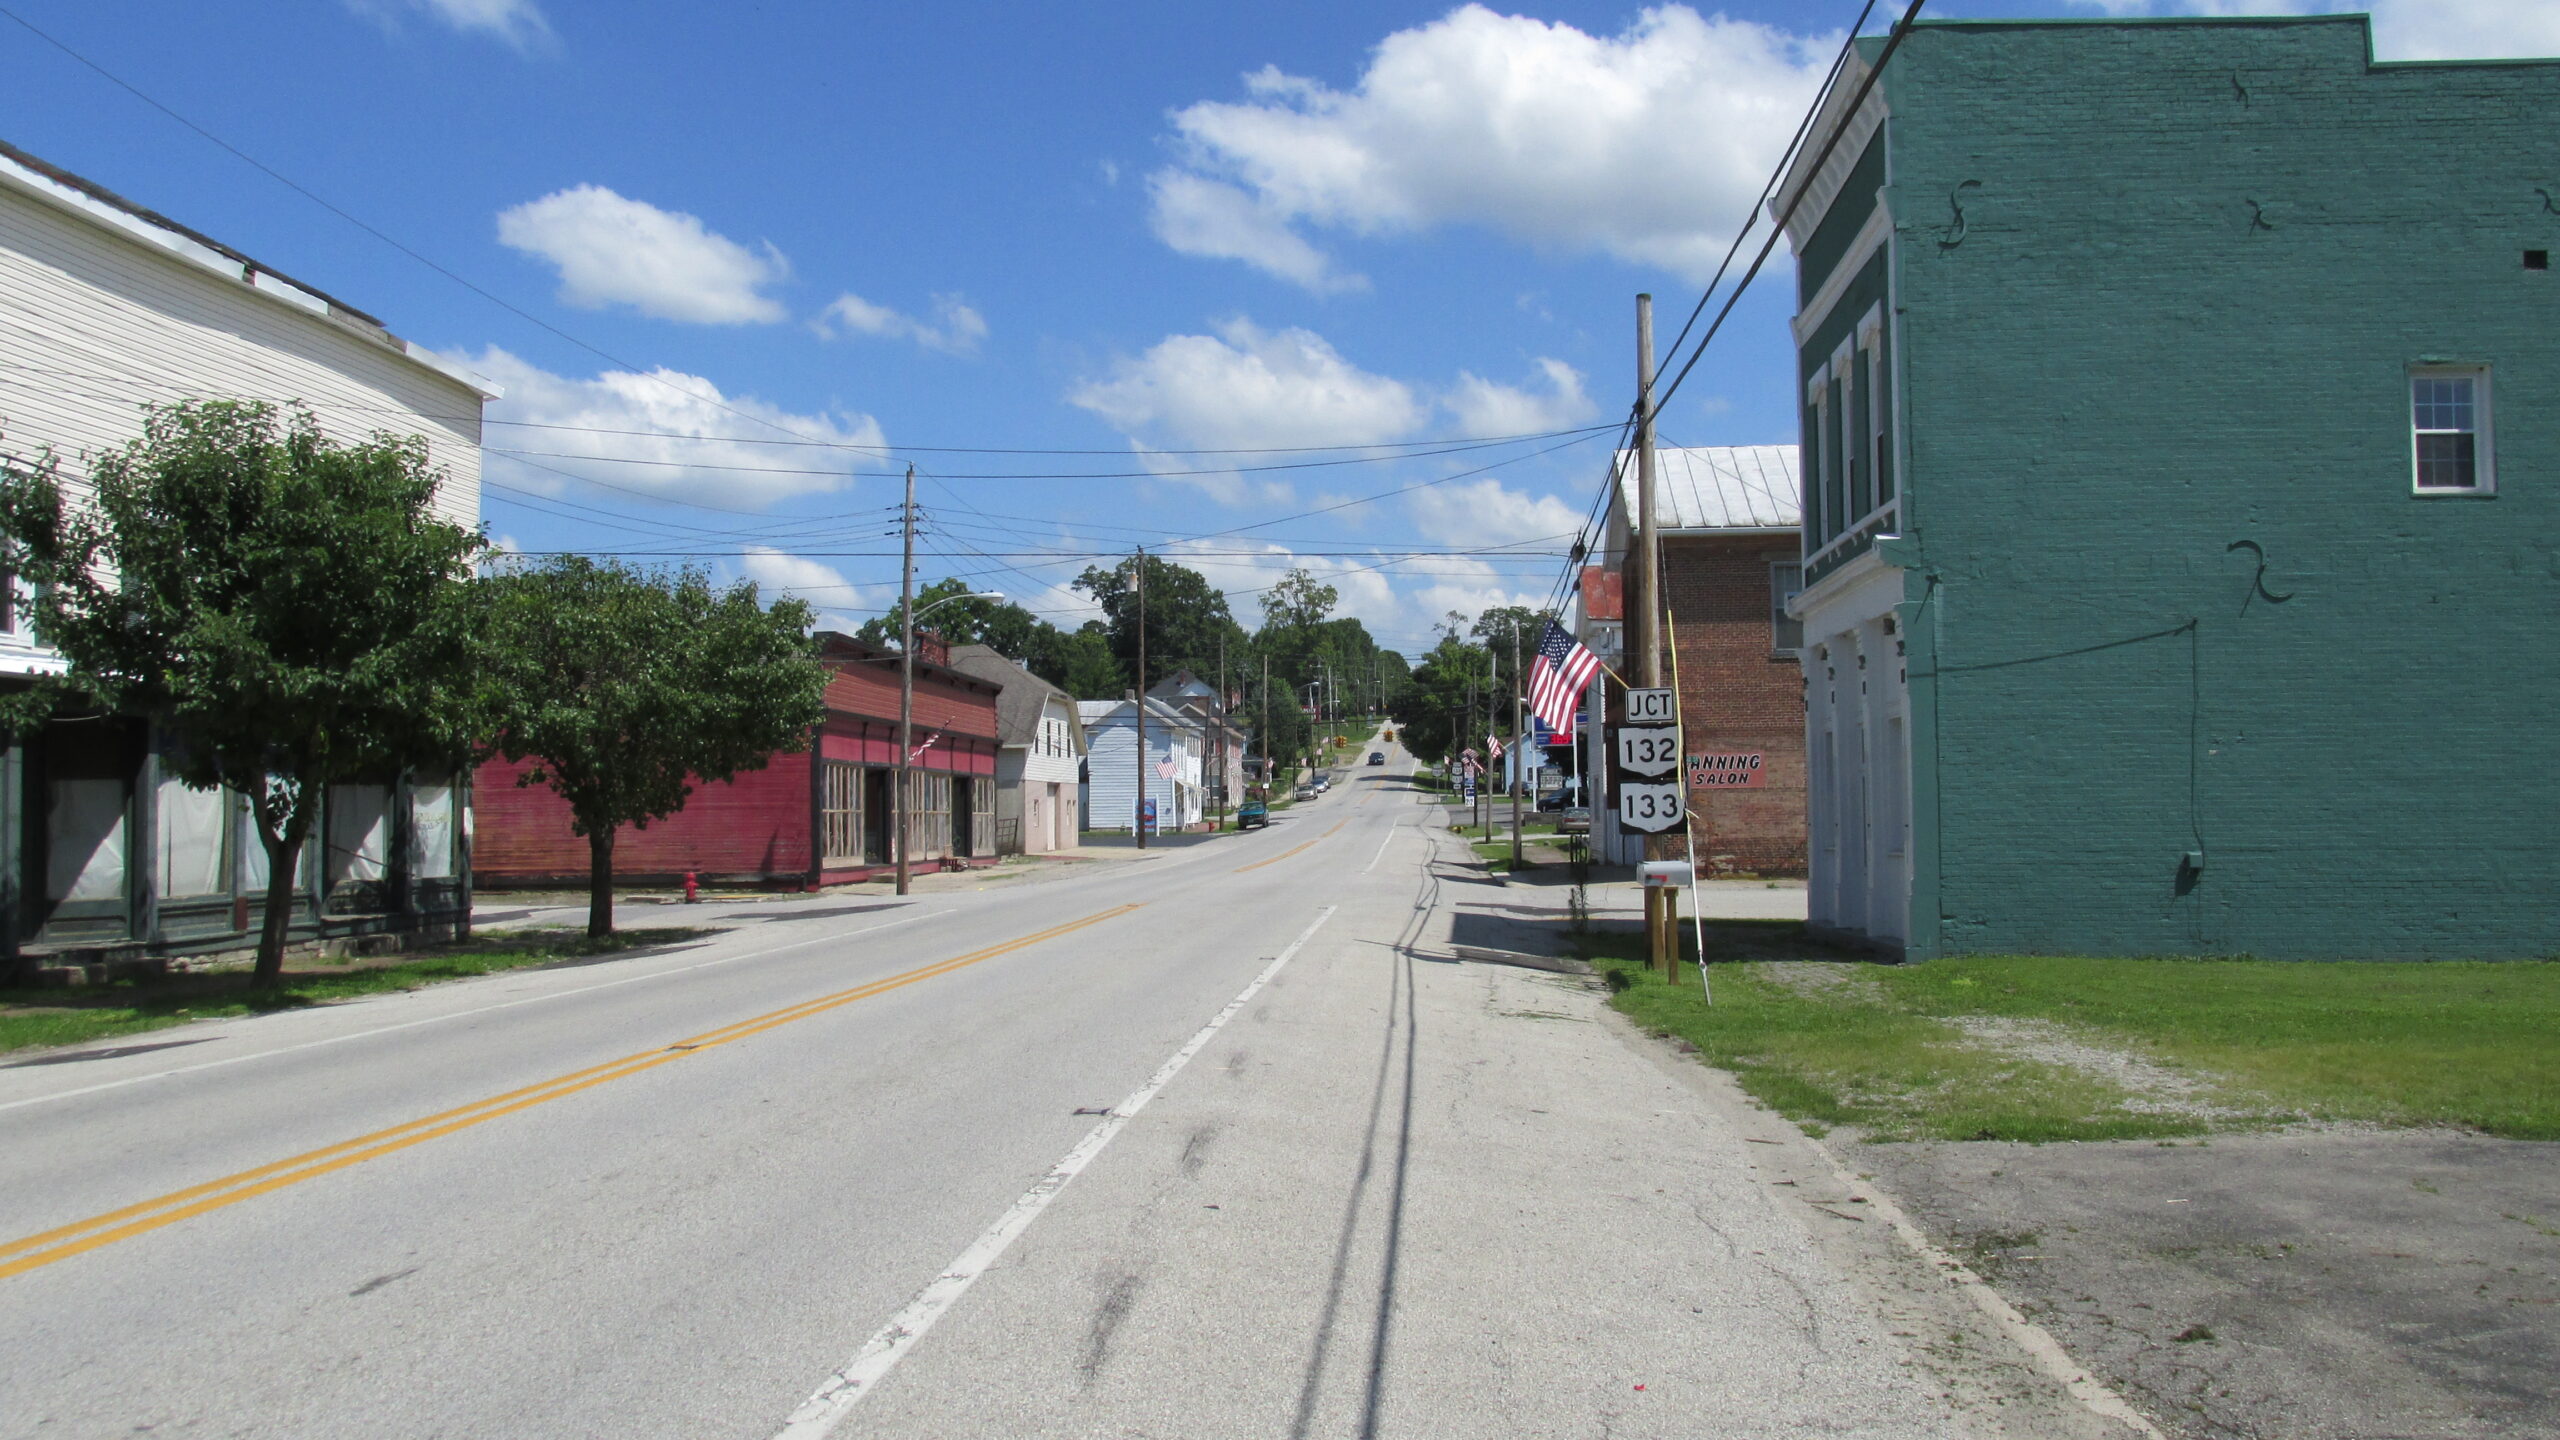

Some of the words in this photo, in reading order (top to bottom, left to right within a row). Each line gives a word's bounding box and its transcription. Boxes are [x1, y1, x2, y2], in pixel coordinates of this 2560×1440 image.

[1630, 694, 1670, 716] JCT
[1625, 738, 1676, 763] 132
[1689, 755, 1760, 770] ANNING
[1695, 773, 1749, 785] SALON
[1626, 794, 1678, 818] 133
